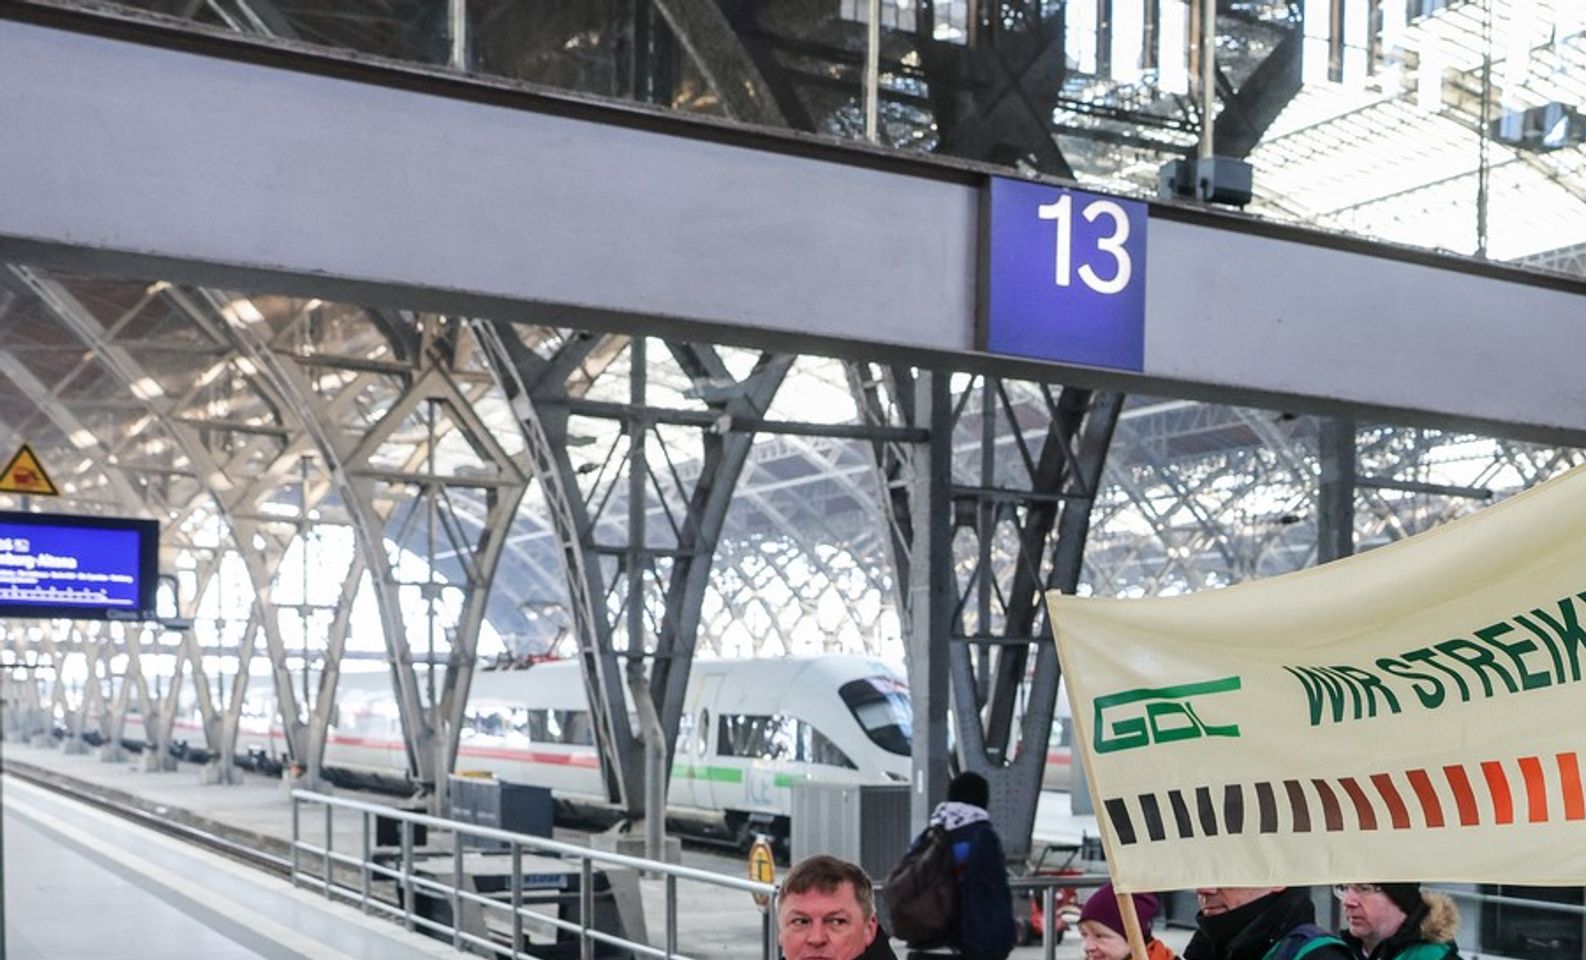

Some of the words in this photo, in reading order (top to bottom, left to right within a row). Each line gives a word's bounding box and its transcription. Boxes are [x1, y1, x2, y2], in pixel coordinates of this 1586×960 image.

[1038, 194, 1132, 294] 13
[1093, 676, 1241, 754] GDL
[1283, 666, 1402, 726] WIR
